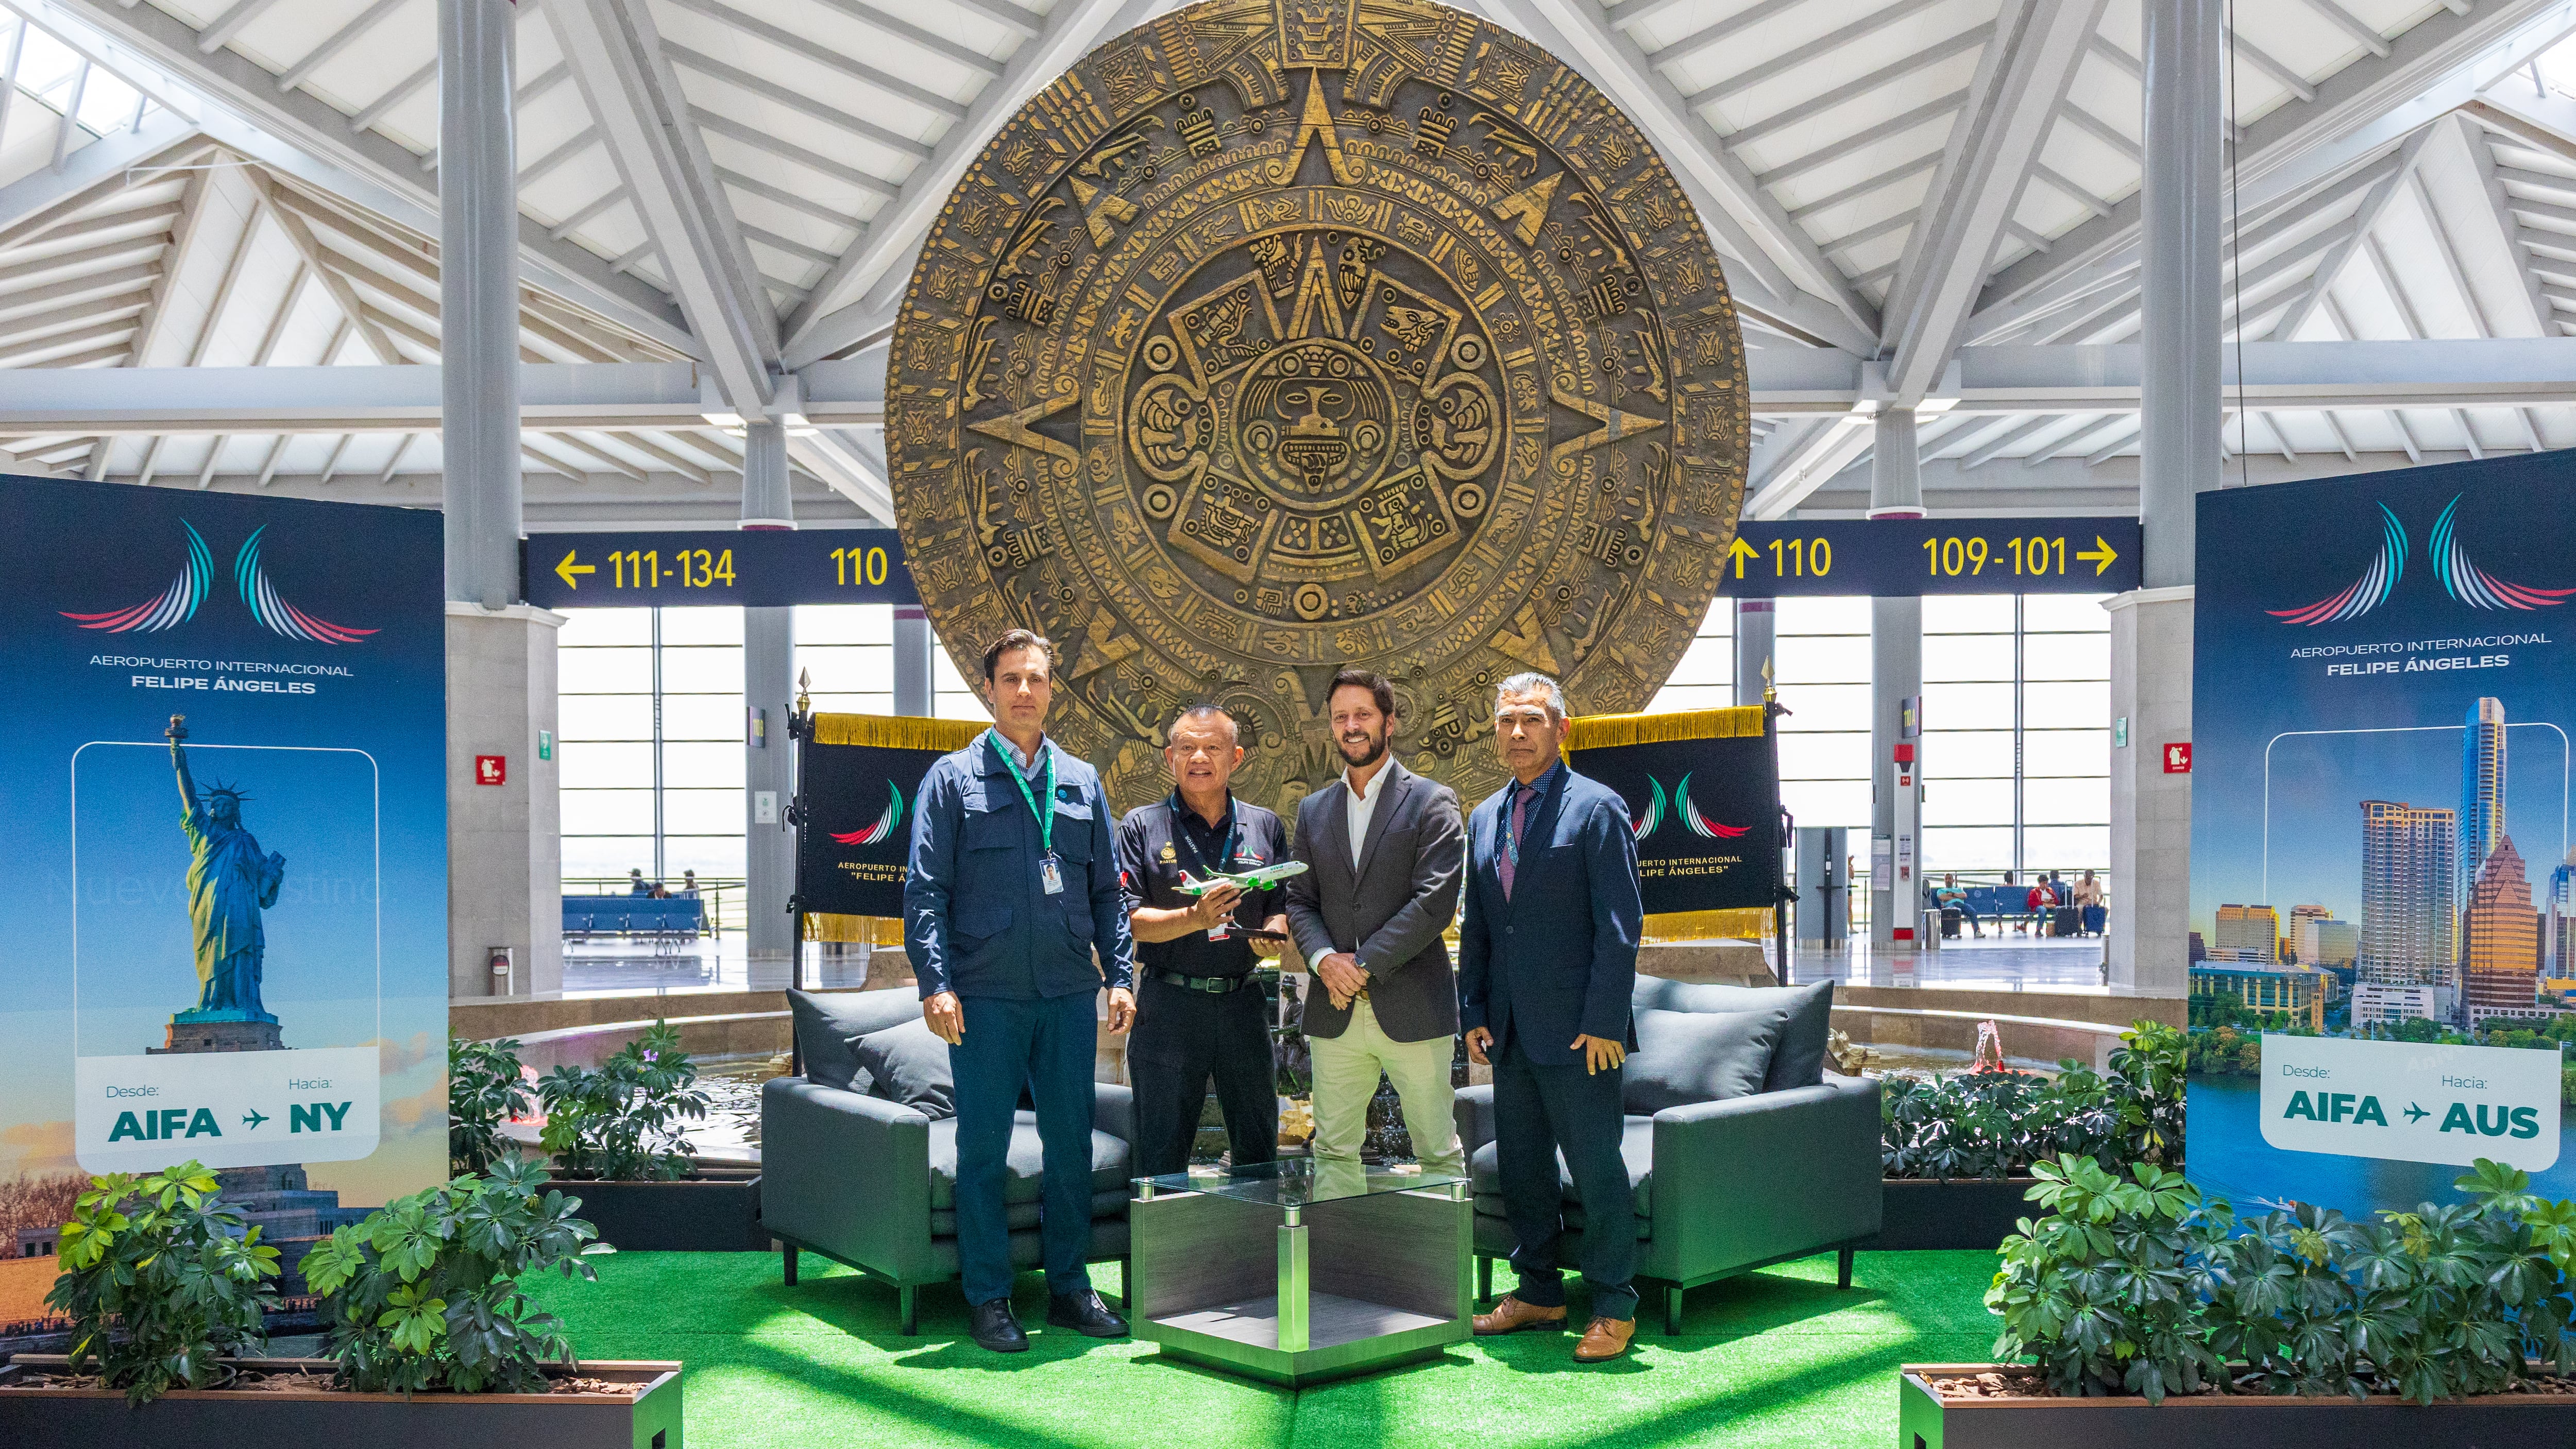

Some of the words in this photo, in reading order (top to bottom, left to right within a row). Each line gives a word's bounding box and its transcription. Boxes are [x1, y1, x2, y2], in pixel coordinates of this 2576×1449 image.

[830, 547, 888, 585] 110
[1768, 537, 1832, 576] 110
[1923, 536, 2065, 576] 109-101
[608, 549, 736, 588] 111-134
[2291, 643, 2403, 658] AEROPUERTO
[2408, 633, 2552, 651] INTERNACIONAL
[90, 655, 211, 670] AEROPUERTO
[216, 661, 353, 676] INTERNACIONAL
[2328, 661, 2399, 676] FELIPE
[2404, 655, 2509, 672] ÁNGELES
[132, 676, 208, 690] FELIPE
[213, 676, 316, 694] ÁNGELES
[1912, 709, 1916, 726] A
[1185, 835, 1198, 854] PASTOR
[838, 862, 896, 872] AEROPUERTO
[1669, 856, 1742, 865] INTERNACIONAL
[1669, 865, 1728, 875] ÁNGELES"
[851, 872, 894, 881] "FELIPE
[2283, 1064, 2330, 1079] Desde:
[2442, 1075, 2487, 1089] Hacia:
[106, 1084, 159, 1098] Desde:
[289, 1078, 332, 1090] Hacia:
[108, 1108, 222, 1141] AIFA
[291, 1102, 352, 1133] NY
[2283, 1091, 2388, 1126] AIFA
[2439, 1103, 2539, 1138] AUS
